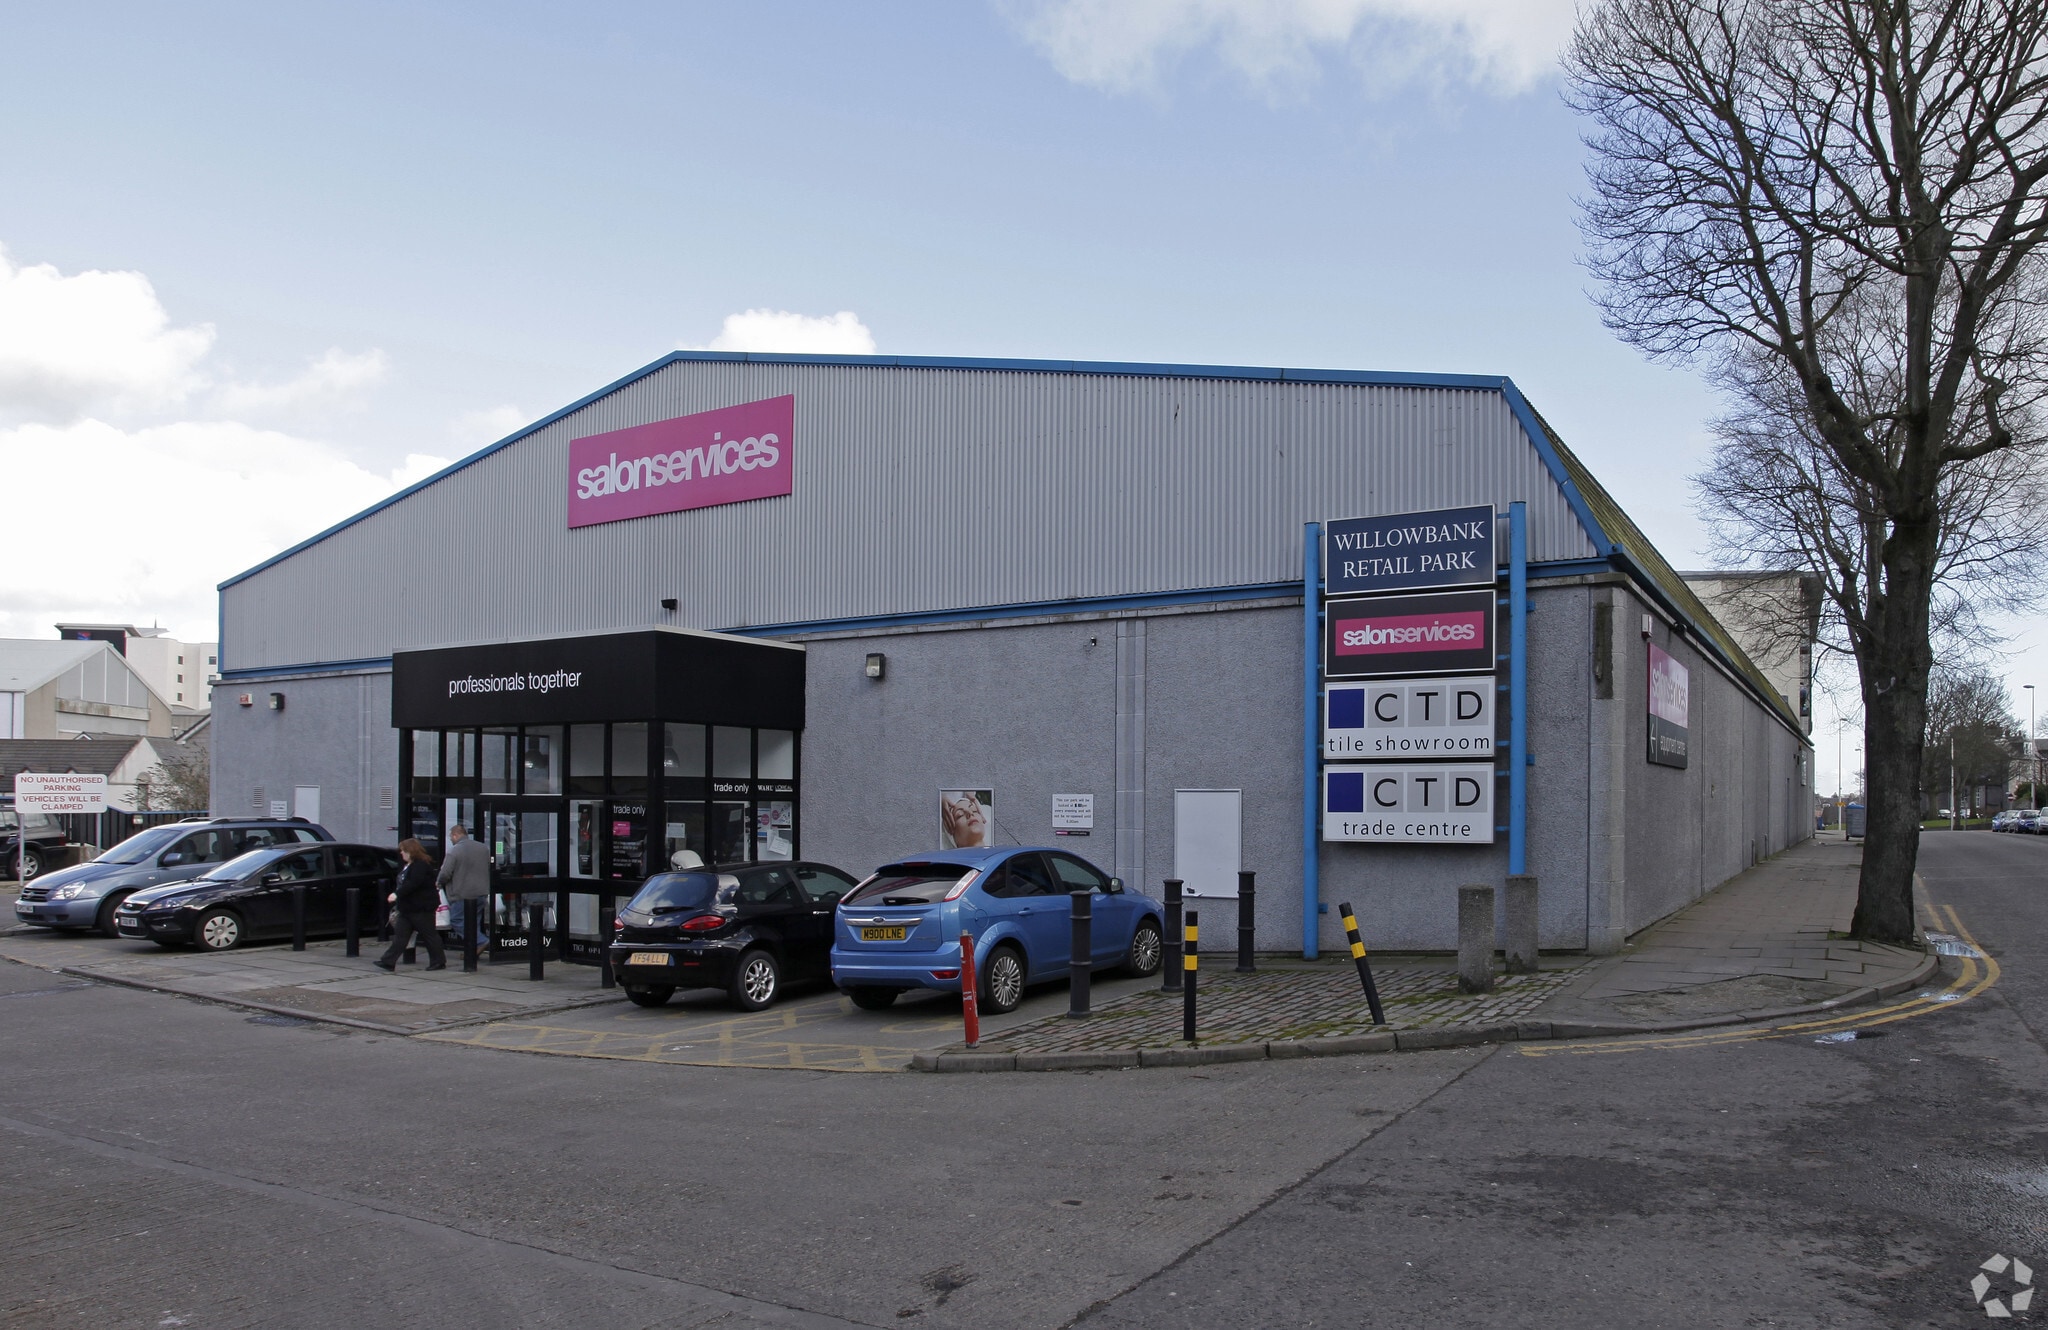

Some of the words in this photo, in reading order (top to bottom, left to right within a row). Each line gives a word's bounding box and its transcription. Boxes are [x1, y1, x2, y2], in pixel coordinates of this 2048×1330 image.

[577, 432, 780, 500] salonservices
[1334, 520, 1486, 551] WILLOWBANK
[1343, 556, 1415, 579] RETAIL
[1420, 551, 1476, 573] PARK
[1343, 620, 1475, 647] salonservices
[449, 672, 525, 698] professionals
[528, 669, 582, 694] together
[1328, 736, 1364, 752] tile
[1376, 735, 1490, 751] showroom
[714, 783, 733, 792] trade
[734, 783, 749, 794] only
[613, 805, 631, 814] trade
[632, 805, 646, 816] only
[1343, 820, 1396, 836] trade
[1404, 821, 1471, 837] centre
[501, 937, 528, 947] trade
[864, 929, 885, 939] M900
[886, 929, 902, 939] LNE
